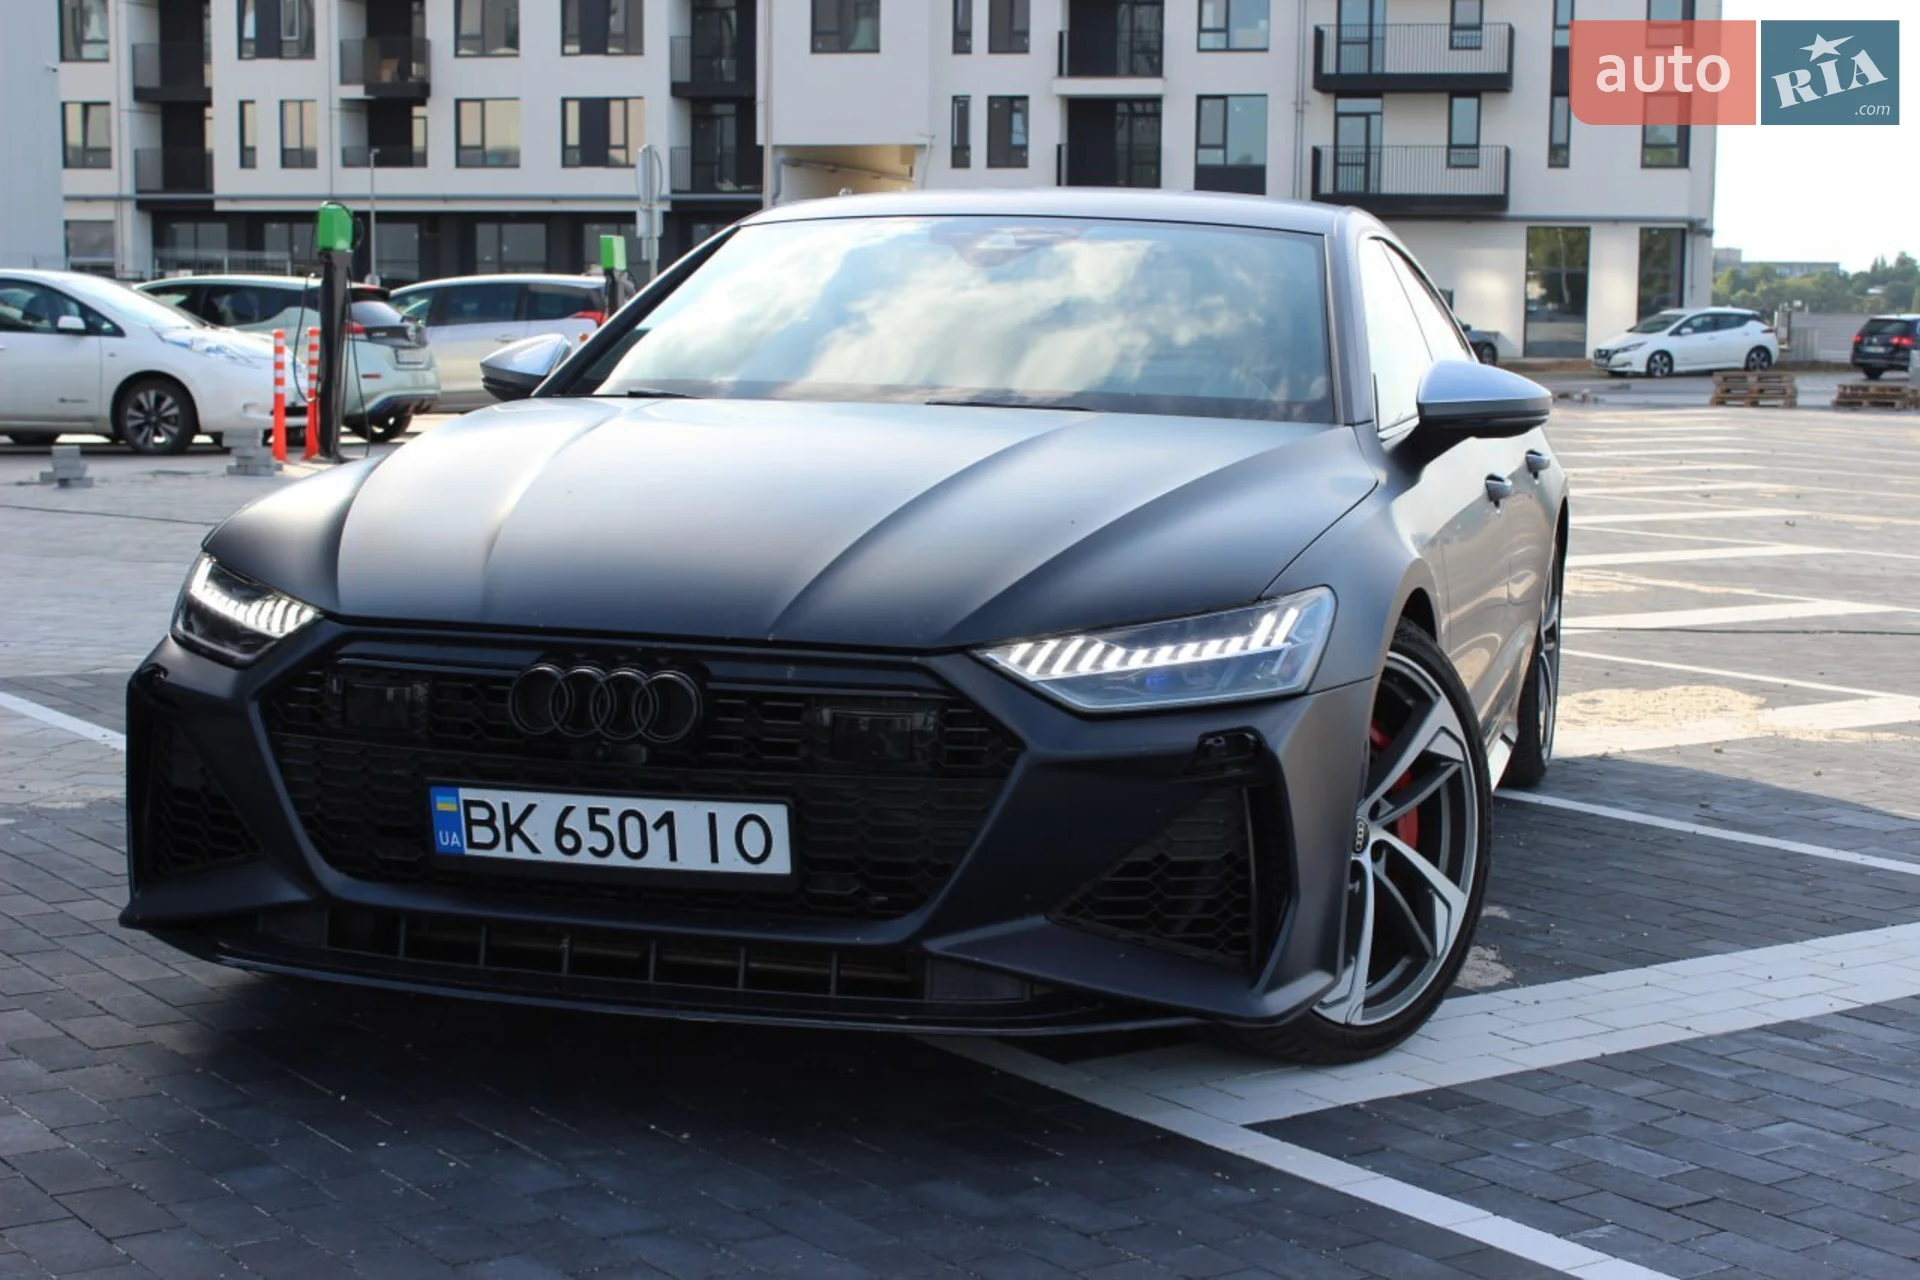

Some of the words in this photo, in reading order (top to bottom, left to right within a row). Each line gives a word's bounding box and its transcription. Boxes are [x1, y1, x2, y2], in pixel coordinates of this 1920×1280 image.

[439, 829, 461, 847] UA
[462, 799, 542, 854] BK
[554, 805, 678, 862] 6501
[707, 812, 773, 865] IO
